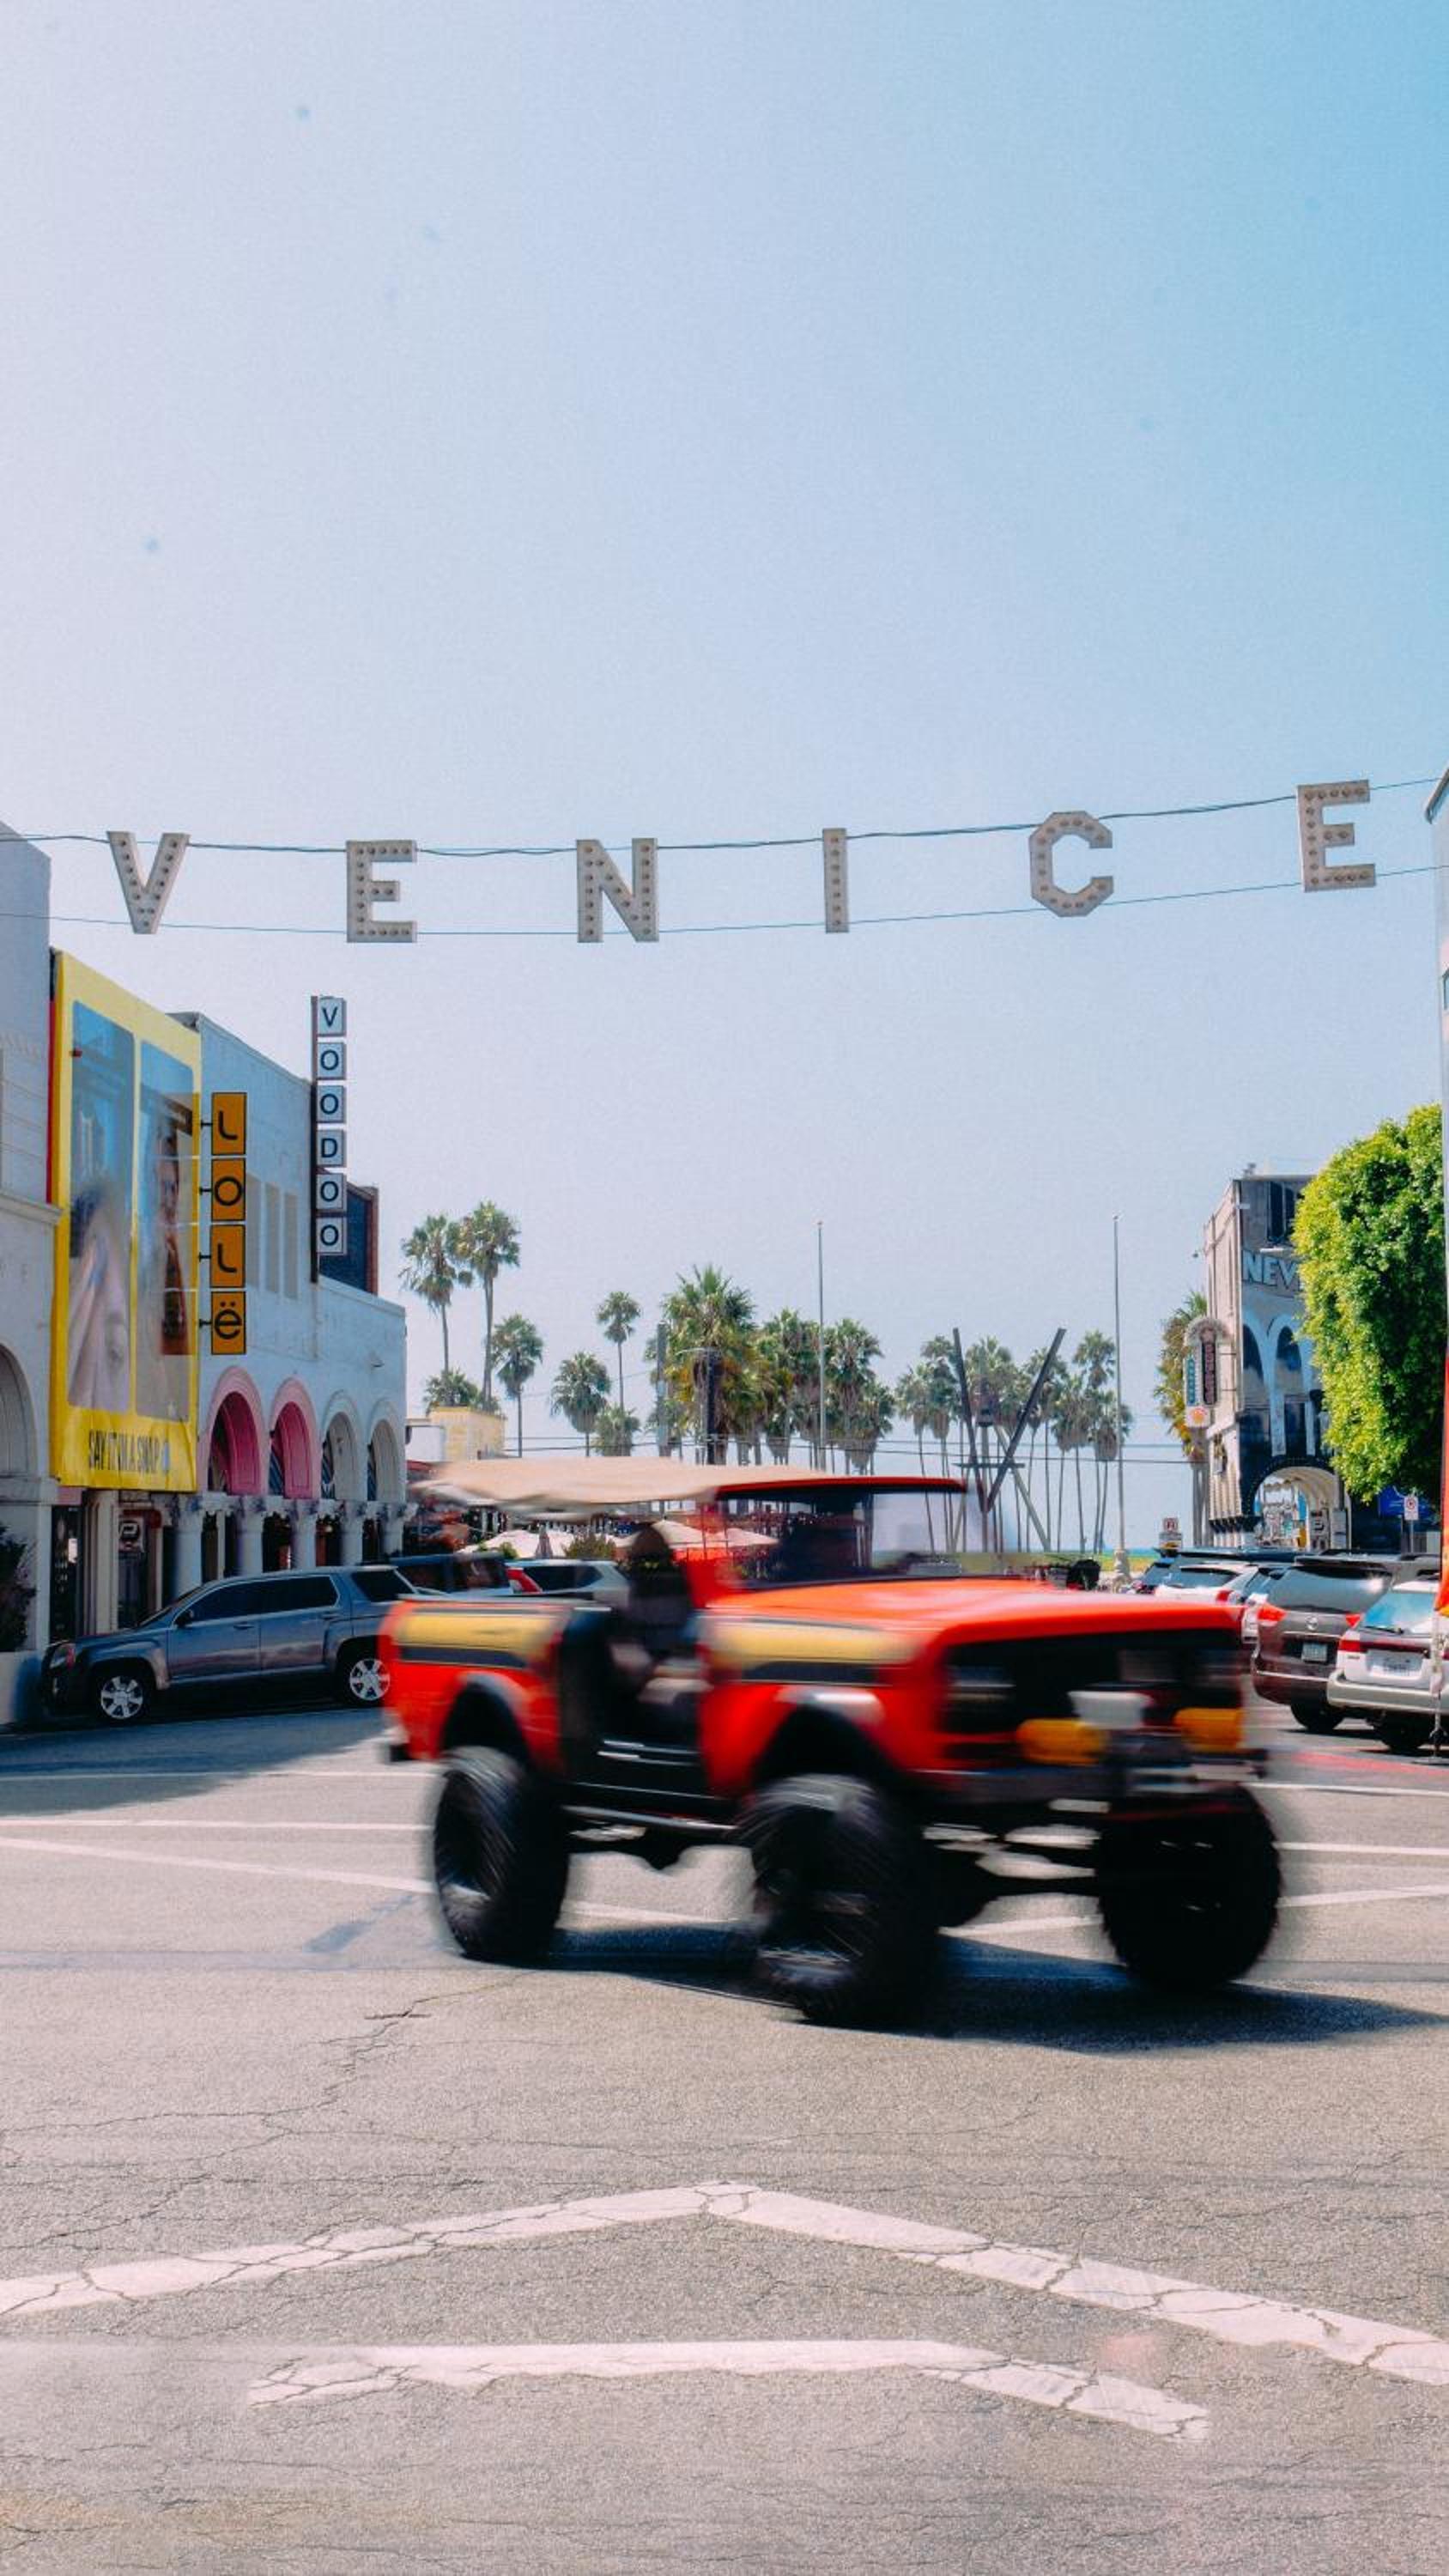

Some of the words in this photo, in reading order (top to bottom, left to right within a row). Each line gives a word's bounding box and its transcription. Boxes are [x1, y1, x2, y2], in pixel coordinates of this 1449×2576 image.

[106, 780, 1376, 943] VENICE
[320, 1006, 339, 1247] VOODOO
[1243, 1250, 1303, 1289] NEV
